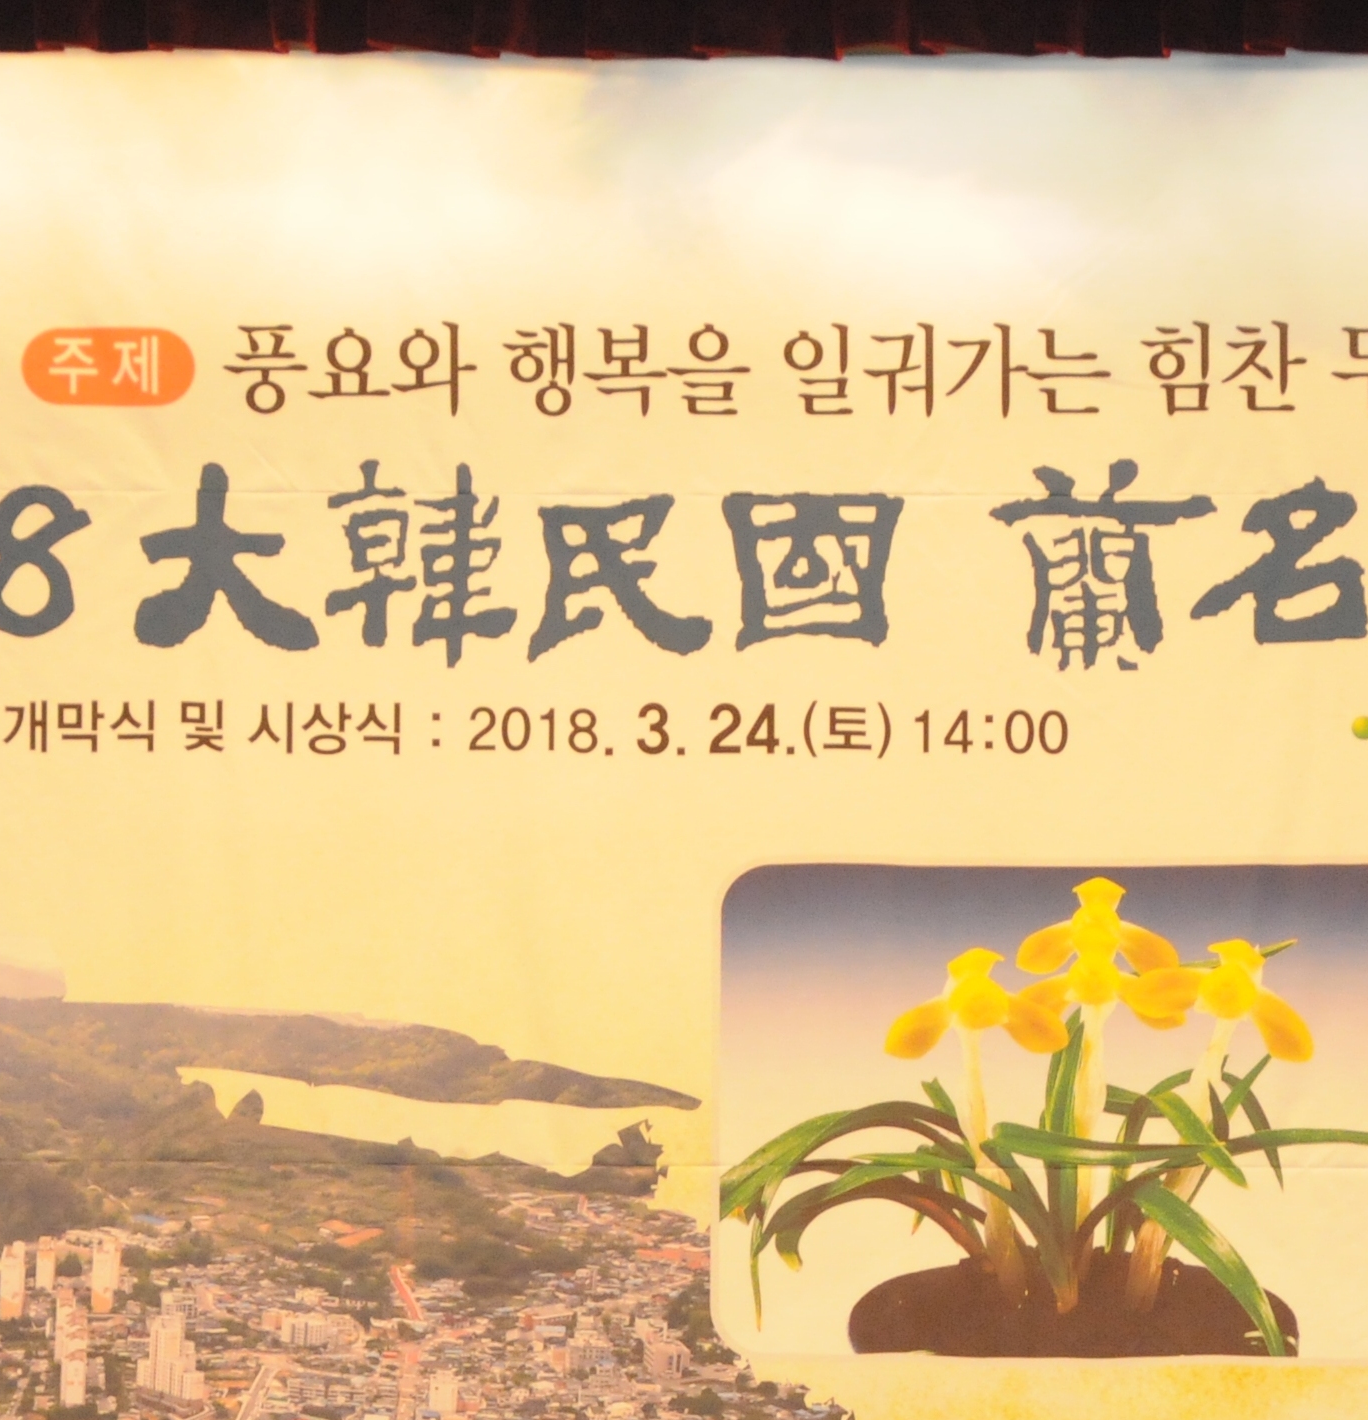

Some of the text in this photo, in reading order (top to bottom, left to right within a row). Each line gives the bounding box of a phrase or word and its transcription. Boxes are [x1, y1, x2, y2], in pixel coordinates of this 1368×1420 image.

[48, 335, 161, 396] 주제
[223, 321, 478, 417] 풍요와
[502, 322, 751, 417] 행복을
[783, 322, 1112, 419] 일궈가는
[1141, 320, 1308, 416] 힘찬
[133, 459, 905, 669] 大韓民國
[3, 699, 155, 753] 개막식
[180, 699, 224, 752] 및
[248, 701, 401, 755] 시상식
[914, 709, 1069, 755] 14:00
